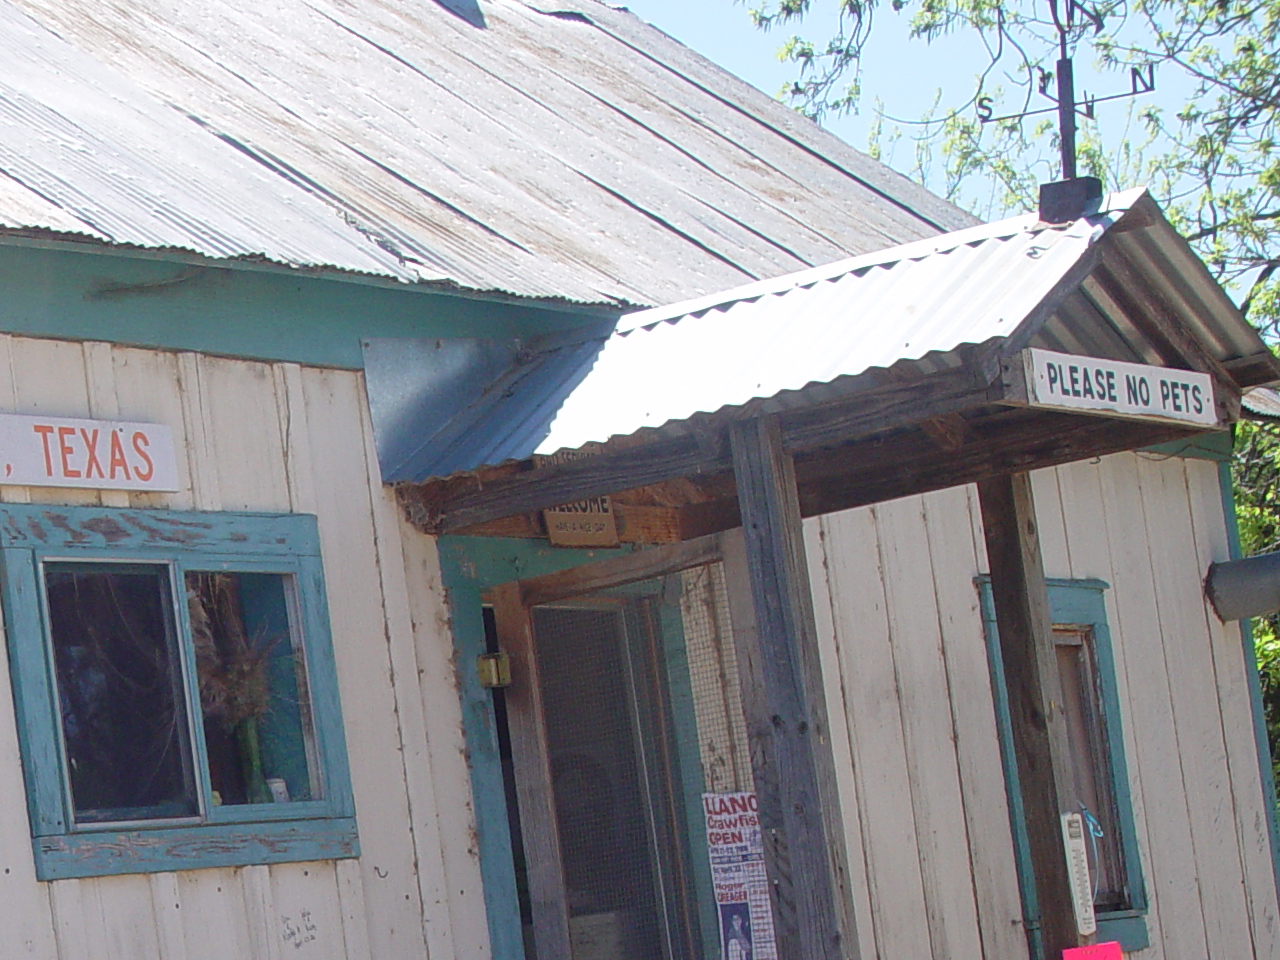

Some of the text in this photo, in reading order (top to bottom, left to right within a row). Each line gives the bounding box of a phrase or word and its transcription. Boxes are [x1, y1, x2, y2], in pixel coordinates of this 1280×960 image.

[1046, 361, 1203, 415] PLEASE NO PETS
[33, 424, 153, 482] TEXAS
[548, 497, 609, 513] LCOME
[704, 794, 759, 816] LLANO
[709, 831, 744, 846] OPEN
